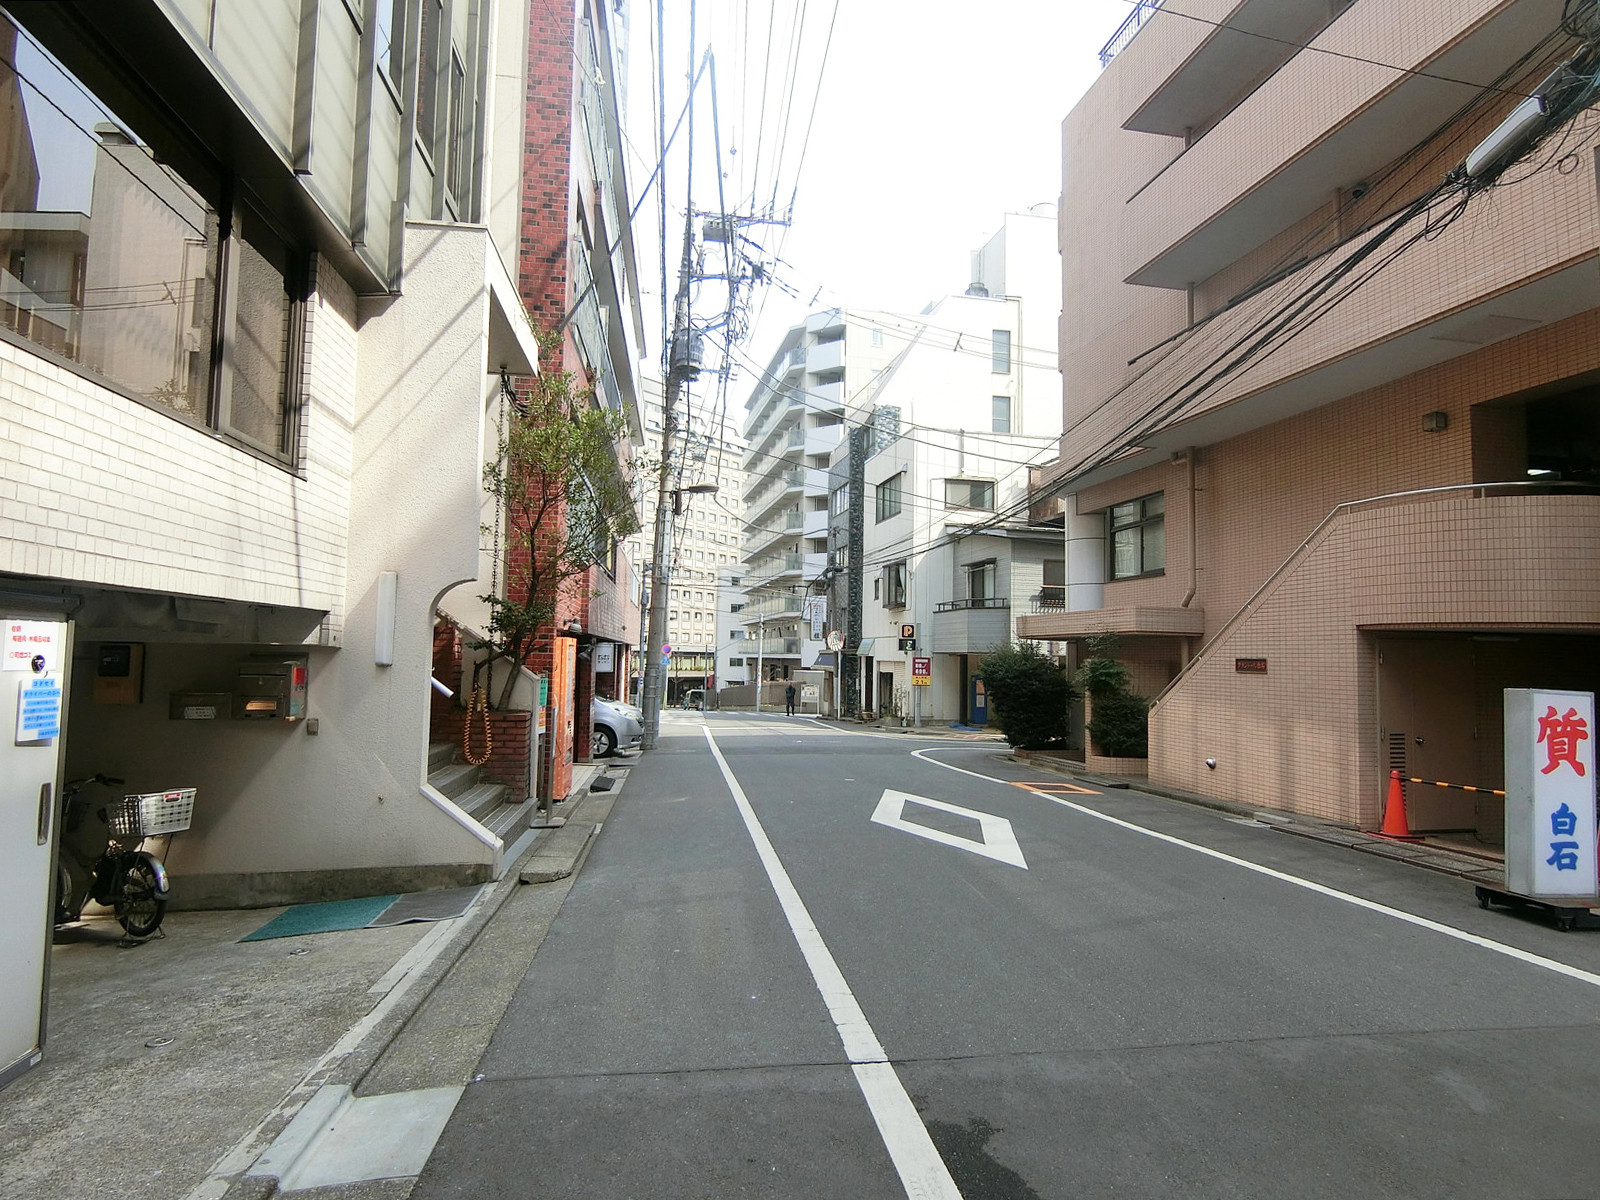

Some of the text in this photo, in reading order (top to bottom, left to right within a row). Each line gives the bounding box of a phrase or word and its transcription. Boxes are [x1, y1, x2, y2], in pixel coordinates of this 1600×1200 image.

[903, 626, 913, 637] P
[1536, 705, 1589, 777] 質
[1546, 802, 1580, 872] 白石
